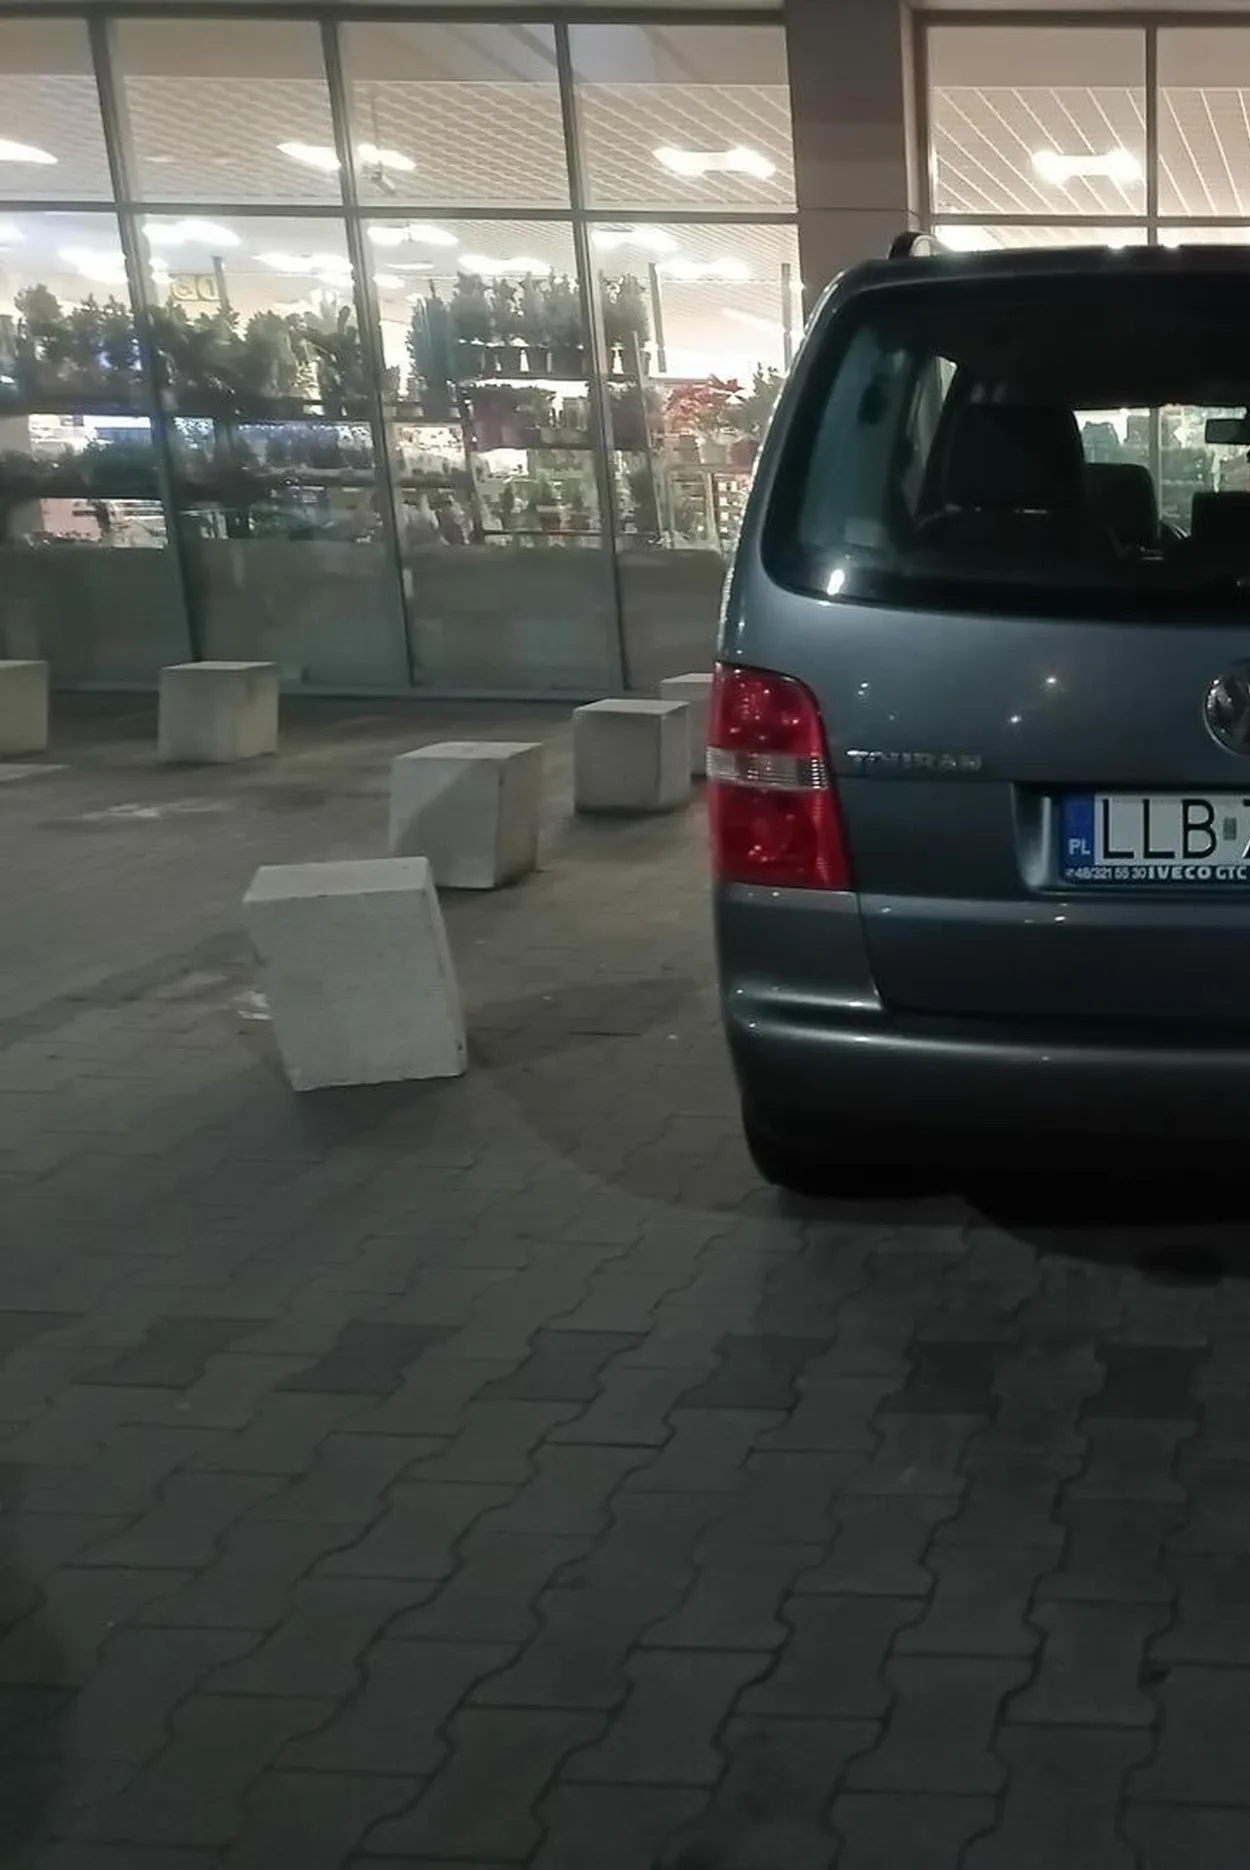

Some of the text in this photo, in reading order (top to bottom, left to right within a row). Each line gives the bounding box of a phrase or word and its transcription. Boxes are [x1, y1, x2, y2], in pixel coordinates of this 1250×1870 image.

[1101, 798, 1218, 860] LLB
[1068, 838, 1091, 855] PL
[1148, 866, 1212, 880] IVECO
[1216, 866, 1247, 880] GTC
